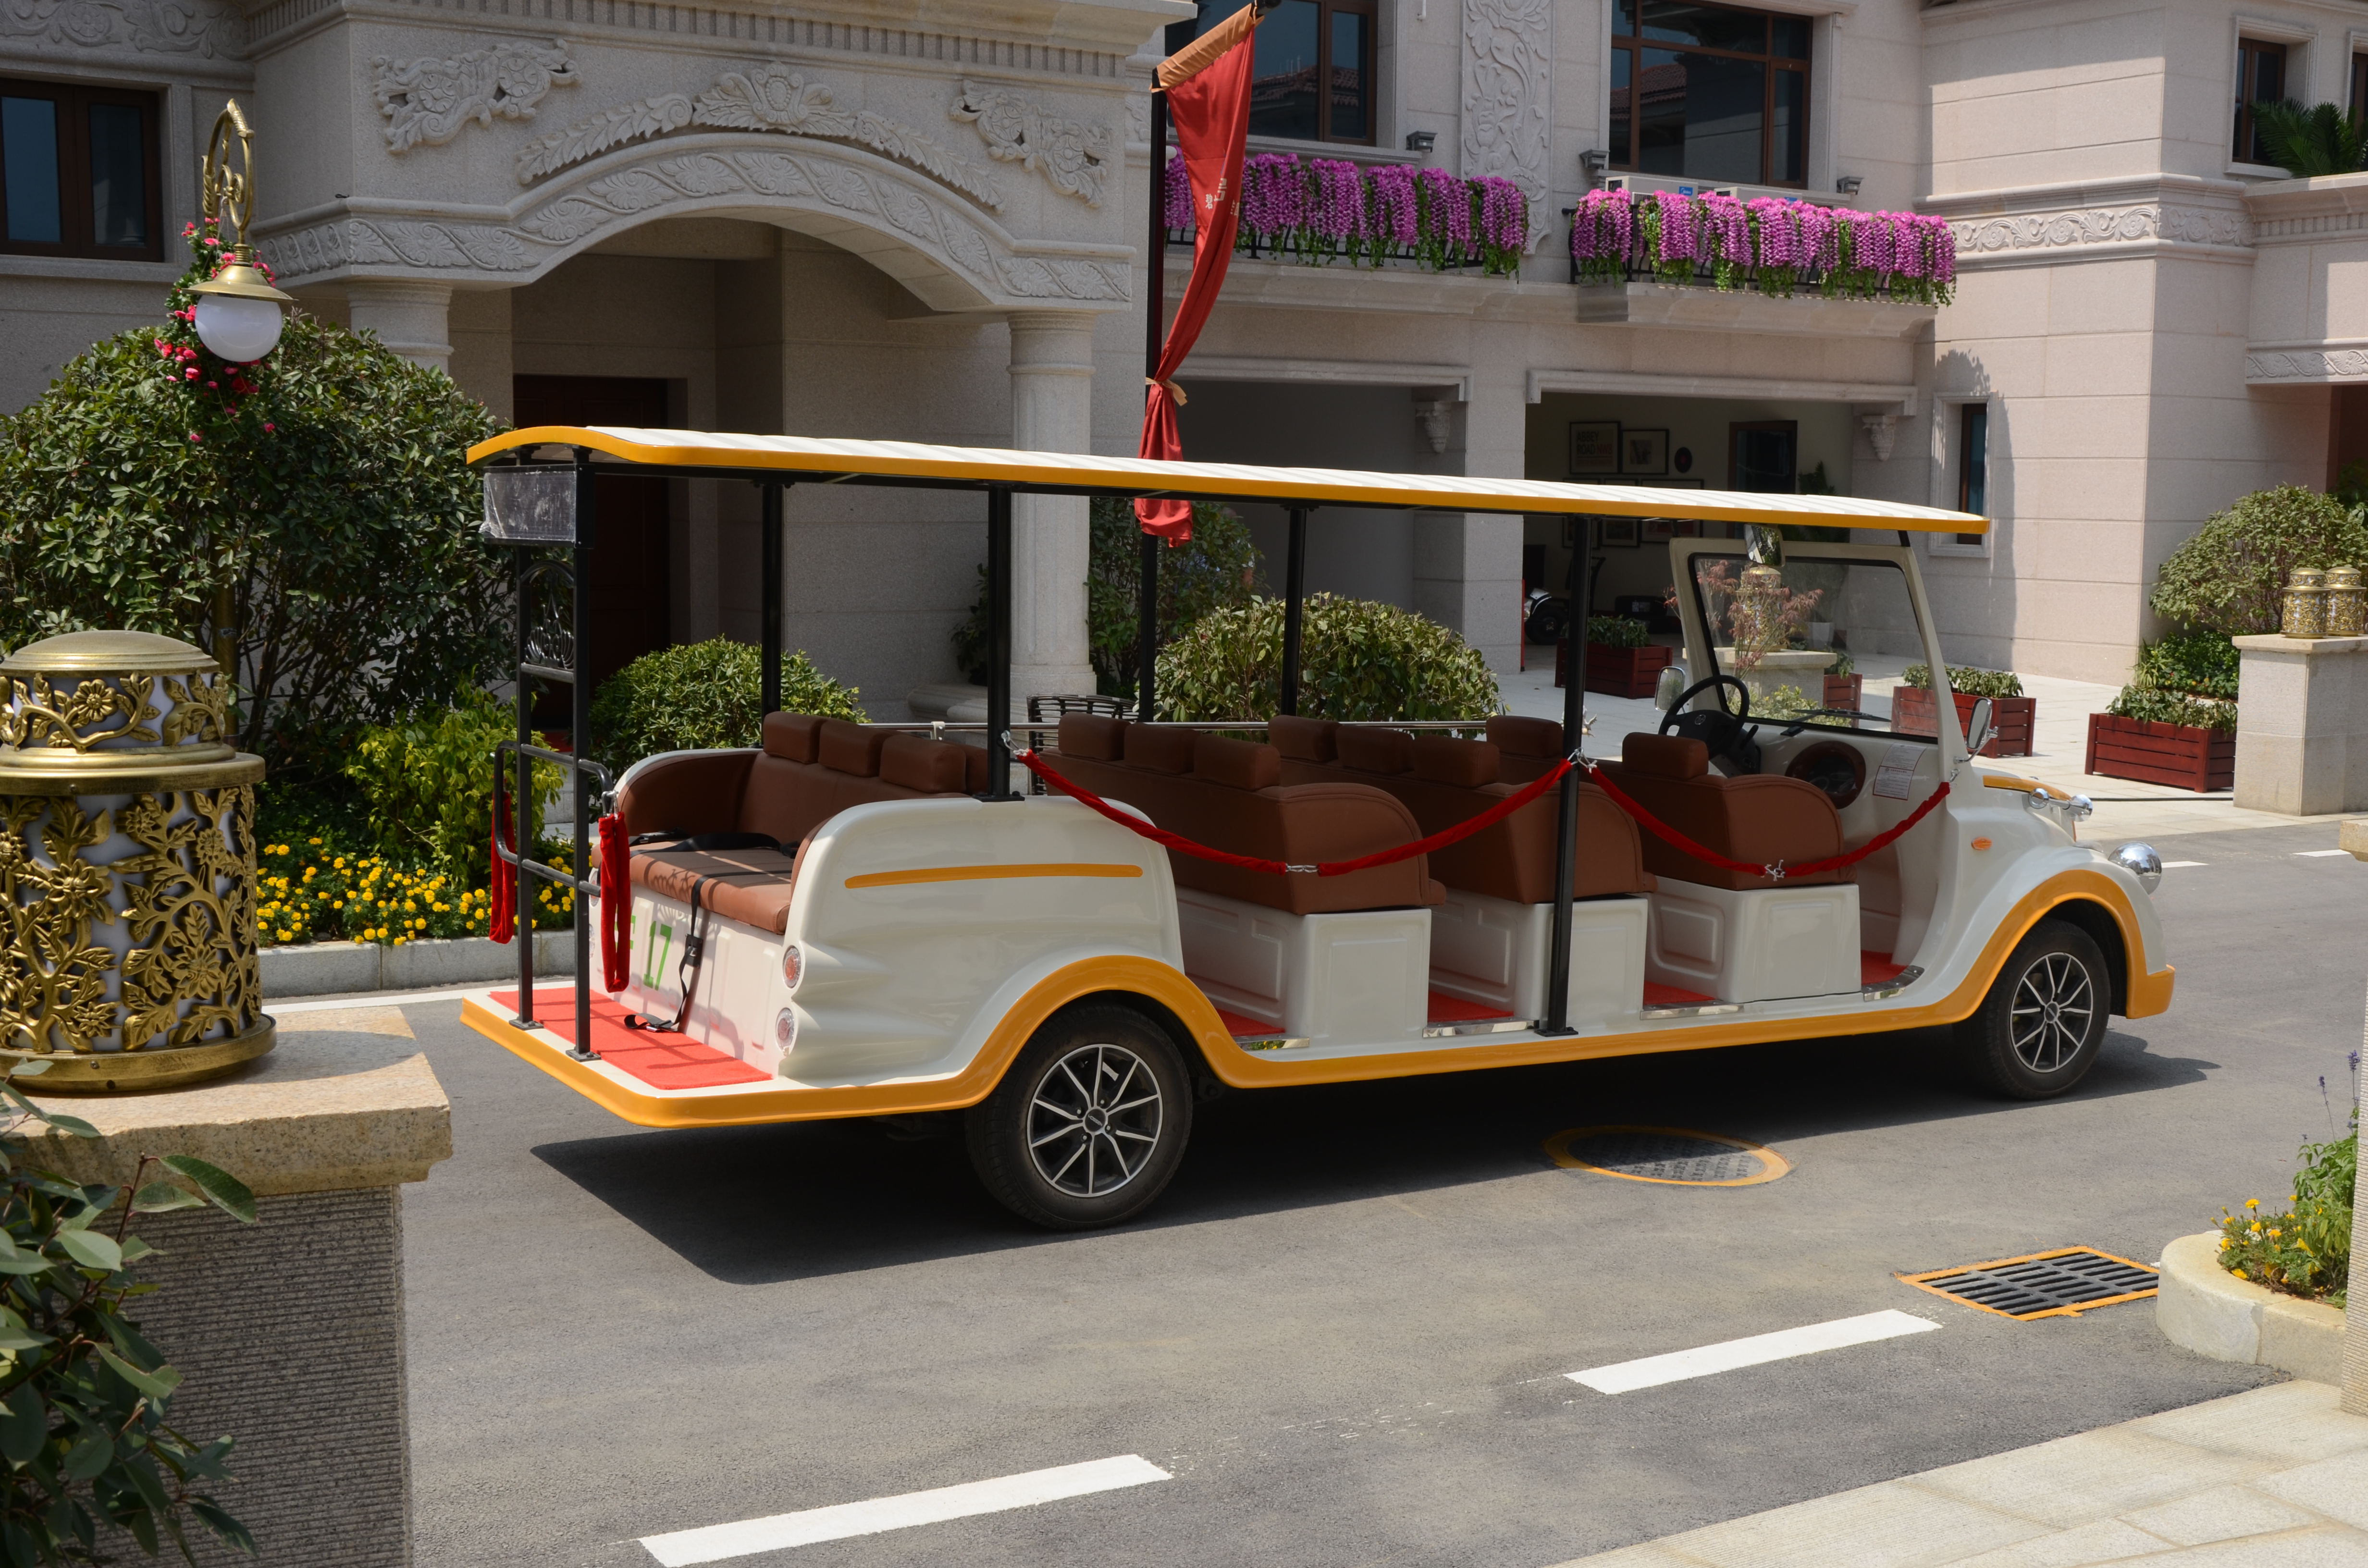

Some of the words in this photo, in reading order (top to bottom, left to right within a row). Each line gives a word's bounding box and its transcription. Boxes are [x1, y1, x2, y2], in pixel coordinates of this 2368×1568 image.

[1577, 431, 1599, 442] ABBEY
[1577, 444, 1596, 454] ROAD
[643, 920, 672, 991] 17
